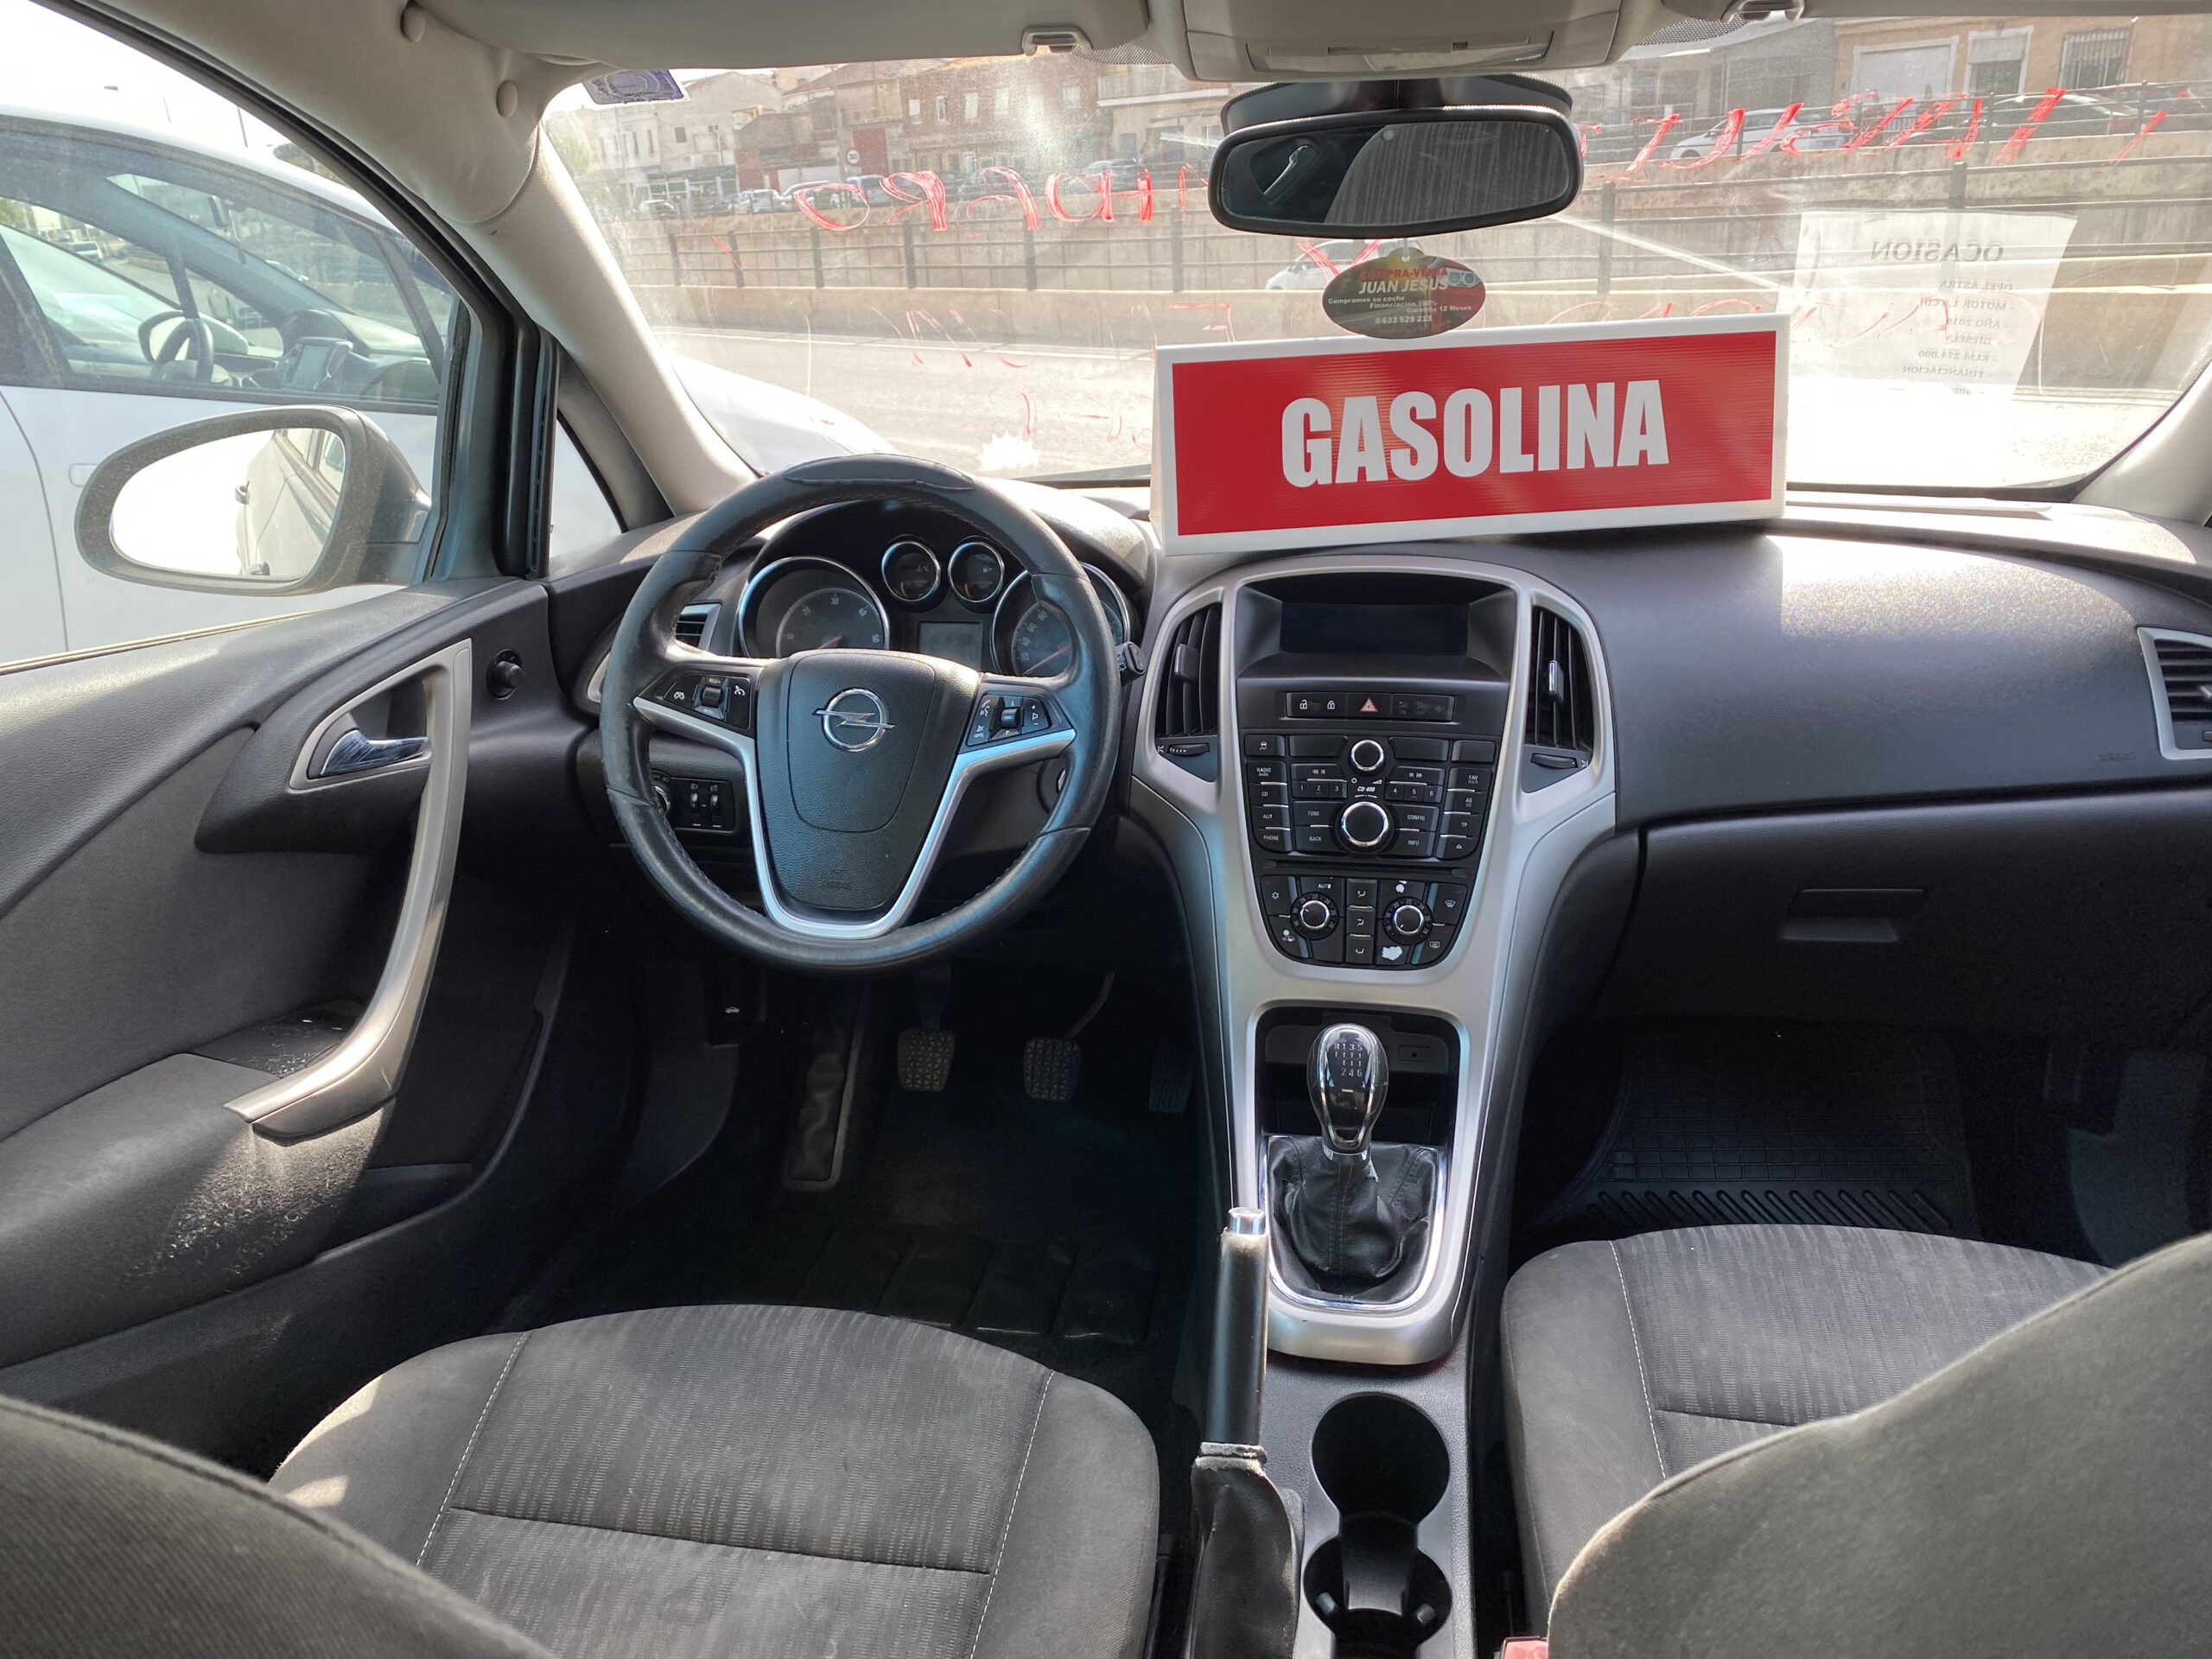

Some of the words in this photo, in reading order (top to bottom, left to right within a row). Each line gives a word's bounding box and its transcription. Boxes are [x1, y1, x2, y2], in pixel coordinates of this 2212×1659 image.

[1359, 268, 1448, 280] COMPRA-VENTA
[1358, 280, 1400, 294] JUAN
[1402, 276, 1448, 292] JESUS
[1281, 380, 1669, 488] GASOLINA
[802, 607, 810, 616] 20
[858, 607, 868, 617] 40
[1027, 623, 1037, 632] 60
[1021, 637, 1031, 646] 40
[1357, 1069, 1363, 1077] 6
